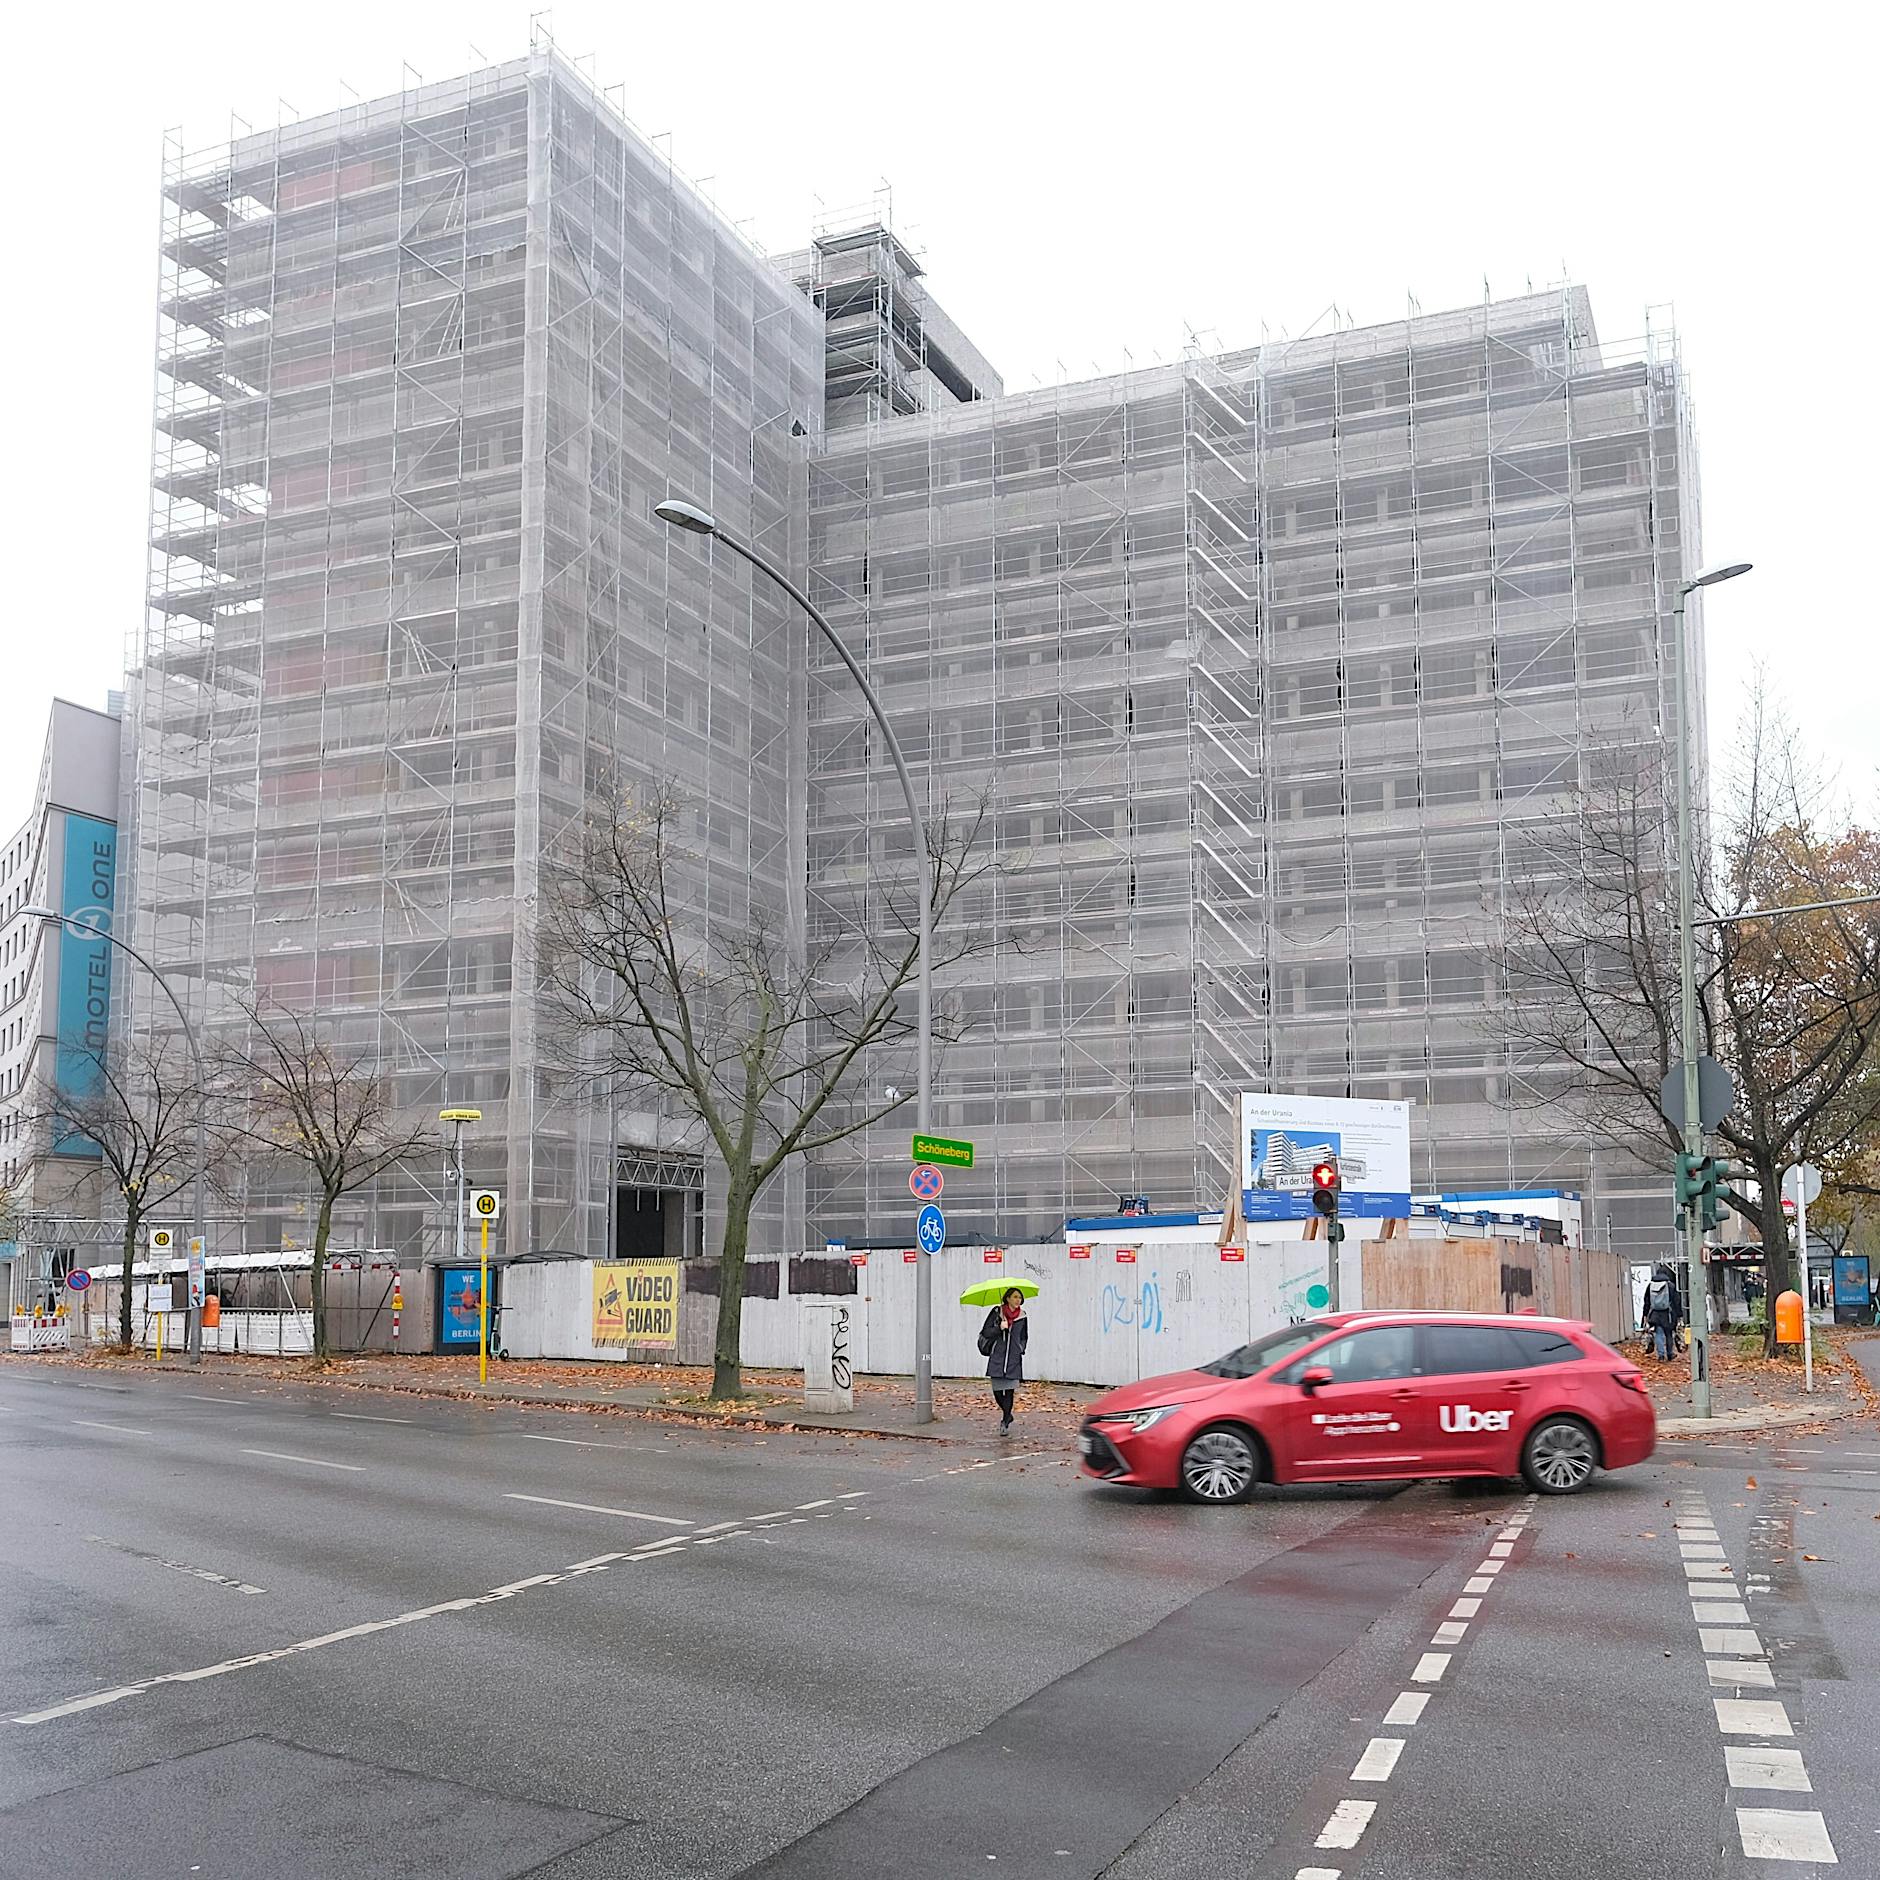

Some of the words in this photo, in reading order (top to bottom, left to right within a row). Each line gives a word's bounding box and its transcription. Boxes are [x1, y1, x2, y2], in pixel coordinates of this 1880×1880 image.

[1272, 1109, 1293, 1117] Urania
[917, 1141, 970, 1161] Schöneberg
[1279, 1177, 1289, 1186] An
[1290, 1175, 1300, 1185] der
[462, 1275, 475, 1283] WE
[625, 1307, 672, 1334] GUARD
[451, 1329, 482, 1339] BERLIN
[1439, 1404, 1514, 1433] Uber
